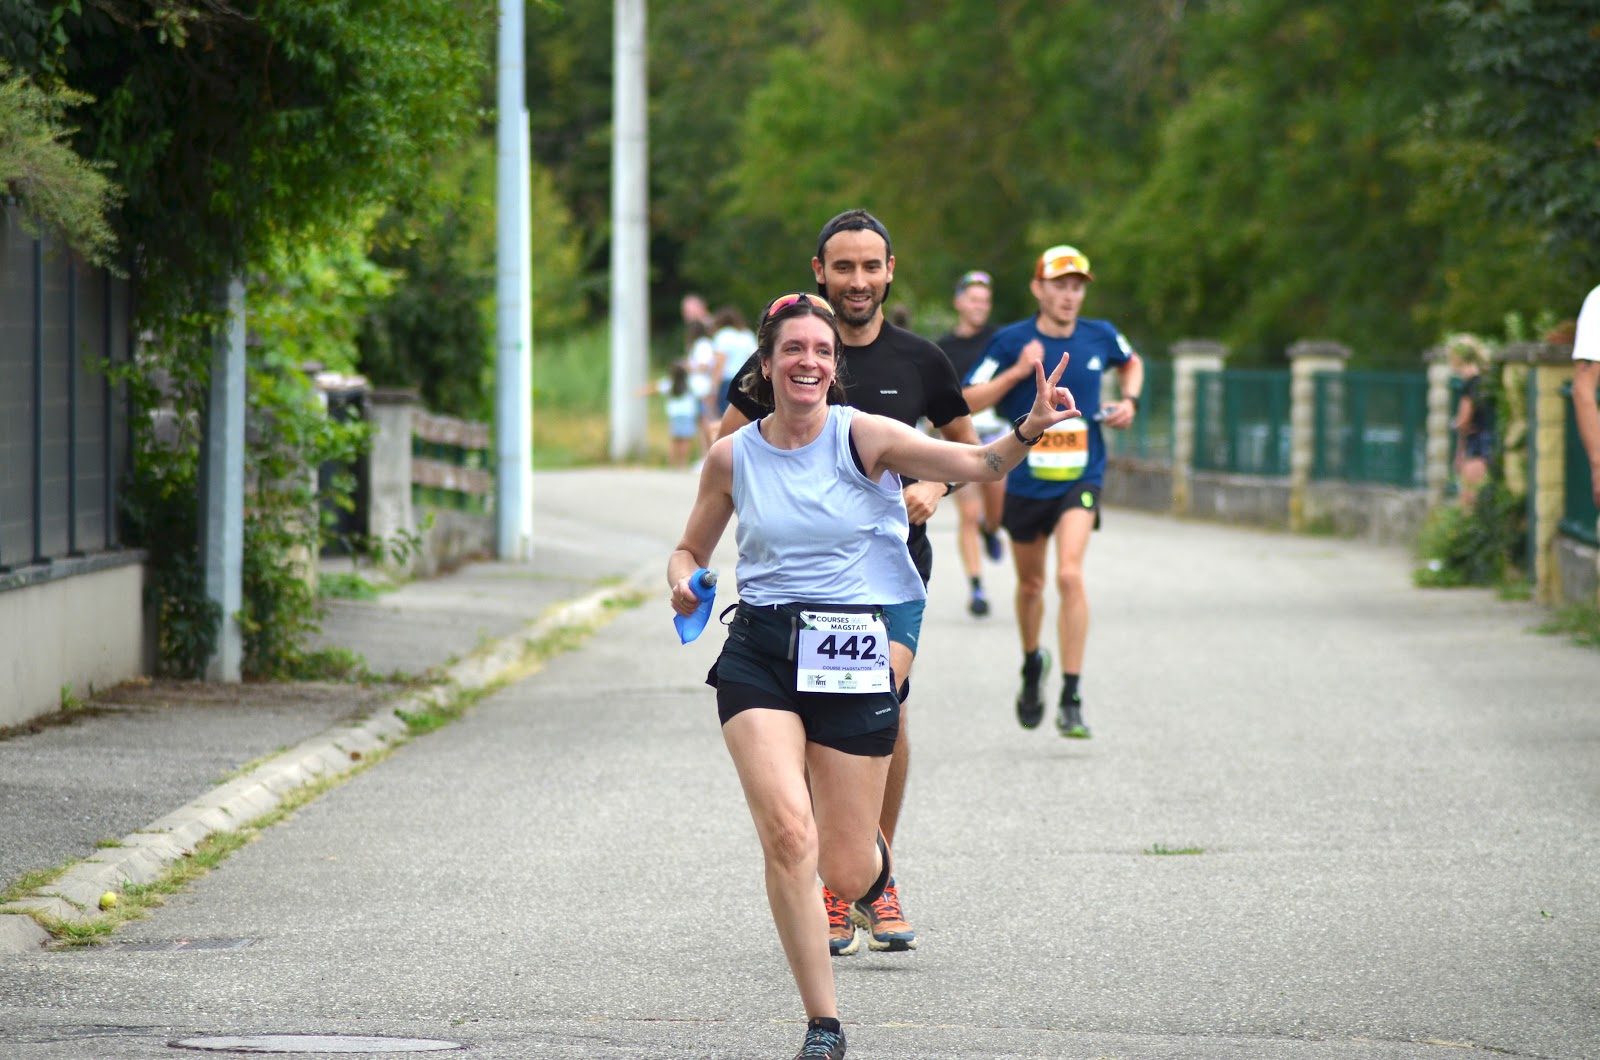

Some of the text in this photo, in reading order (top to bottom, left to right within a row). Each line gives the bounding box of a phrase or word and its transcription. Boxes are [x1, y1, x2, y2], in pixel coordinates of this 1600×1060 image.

[1041, 432, 1077, 447] 208
[816, 616, 849, 624] COURSES
[816, 634, 877, 660] 442
